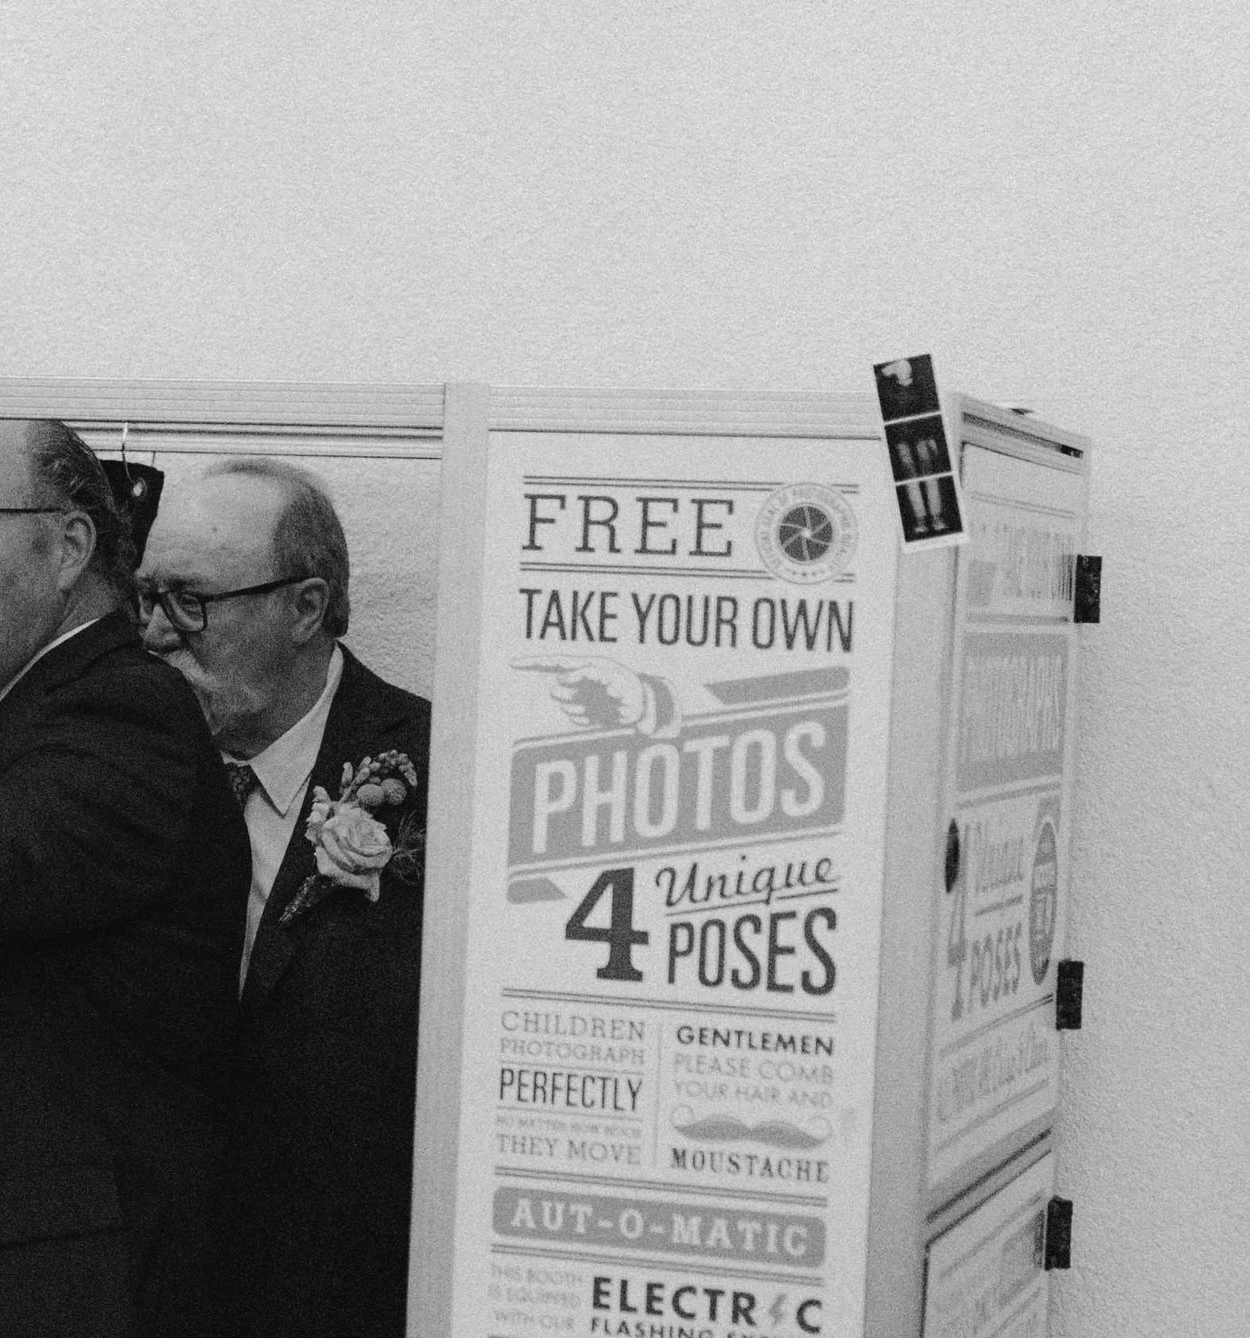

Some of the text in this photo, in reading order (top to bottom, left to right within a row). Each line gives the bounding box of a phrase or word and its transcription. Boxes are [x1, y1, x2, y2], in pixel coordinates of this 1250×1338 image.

[522, 493, 734, 557] FREE
[519, 588, 854, 653] TAKE YOUR OWN
[532, 720, 827, 854] PHOTOS
[655, 854, 840, 907] Unique
[565, 867, 650, 982] 4
[667, 907, 837, 996] POSES
[500, 1010, 646, 1042] CHILDREN
[676, 1025, 834, 1057] GENTLEMEN
[499, 1037, 646, 1066] PHOTOGRAPH
[674, 1053, 833, 1085] PLEASE COMB
[499, 1067, 643, 1112] PERFECTLY
[674, 1080, 833, 1109] YOUR HAIR AND
[496, 1133, 642, 1166] THEY MOVE
[670, 1147, 830, 1183] MOUSTACHE
[510, 1198, 808, 1256] AUT-O-MATIC
